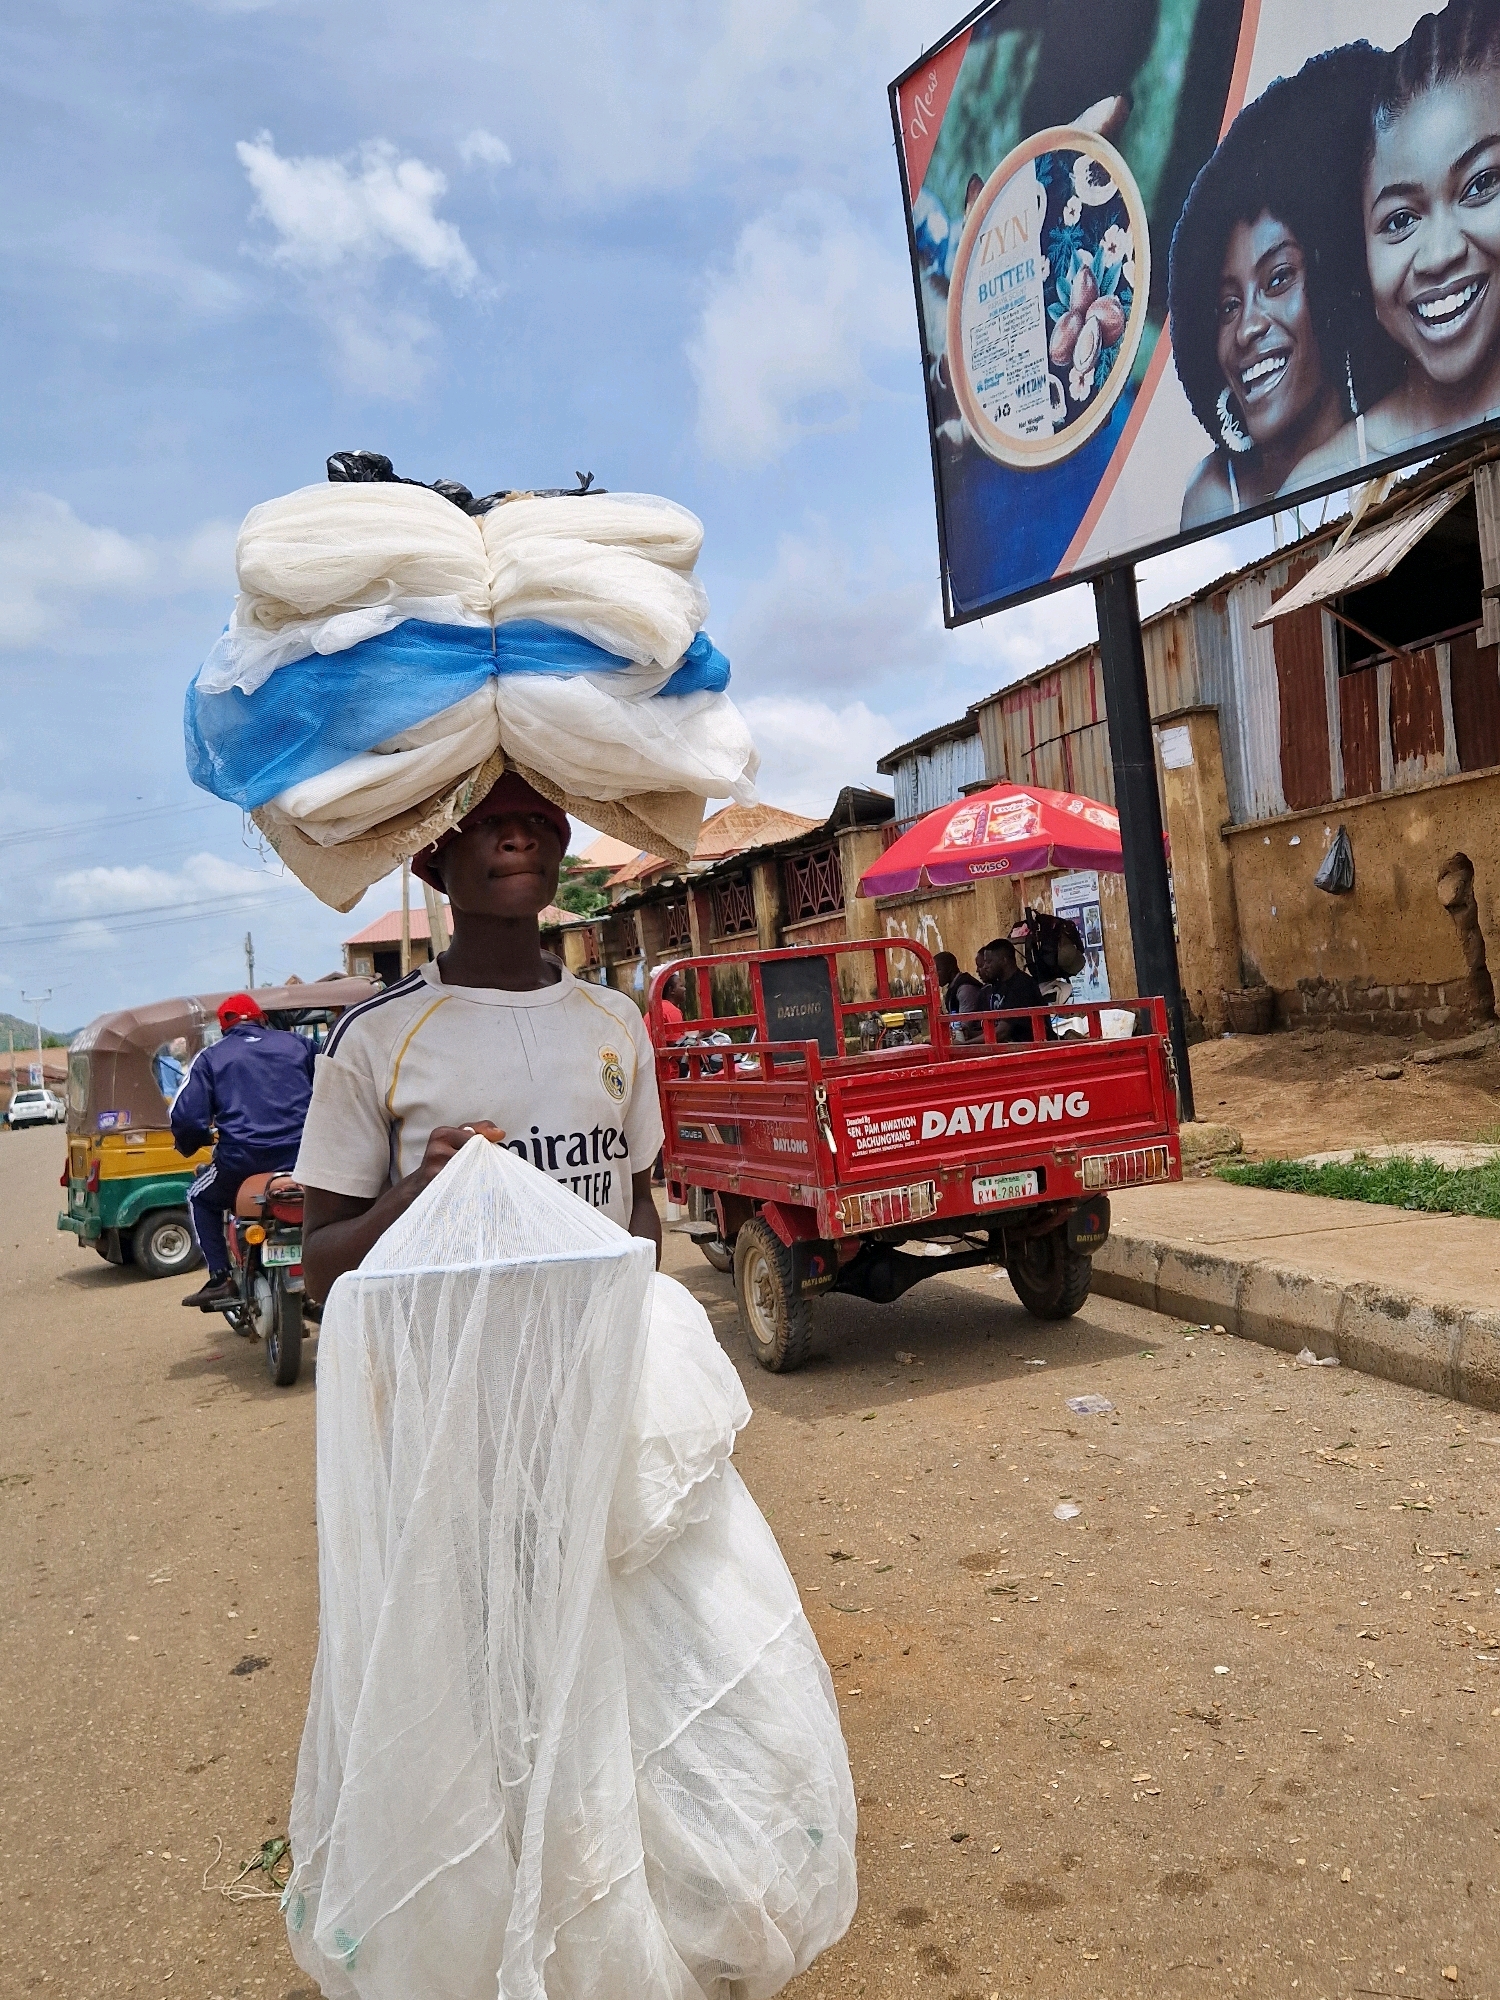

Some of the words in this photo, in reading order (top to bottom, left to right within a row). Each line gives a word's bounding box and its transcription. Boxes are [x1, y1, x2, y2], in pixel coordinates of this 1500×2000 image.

[911, 69, 938, 138] New
[980, 209, 1029, 267] ZYN
[979, 258, 1035, 303] BUTTER
[970, 859, 1009, 872] twisco
[777, 1002, 822, 1018] DAYLONG
[922, 1092, 1089, 1139] DAYLONG
[680, 1129, 703, 1139] POWER
[864, 1123, 880, 1136] PAM
[880, 1116, 917, 1132] MWATKON
[773, 1138, 808, 1154] DAYLONG
[857, 1130, 911, 1150] DACHUNGYANG
[557, 1171, 611, 1207] TTER
